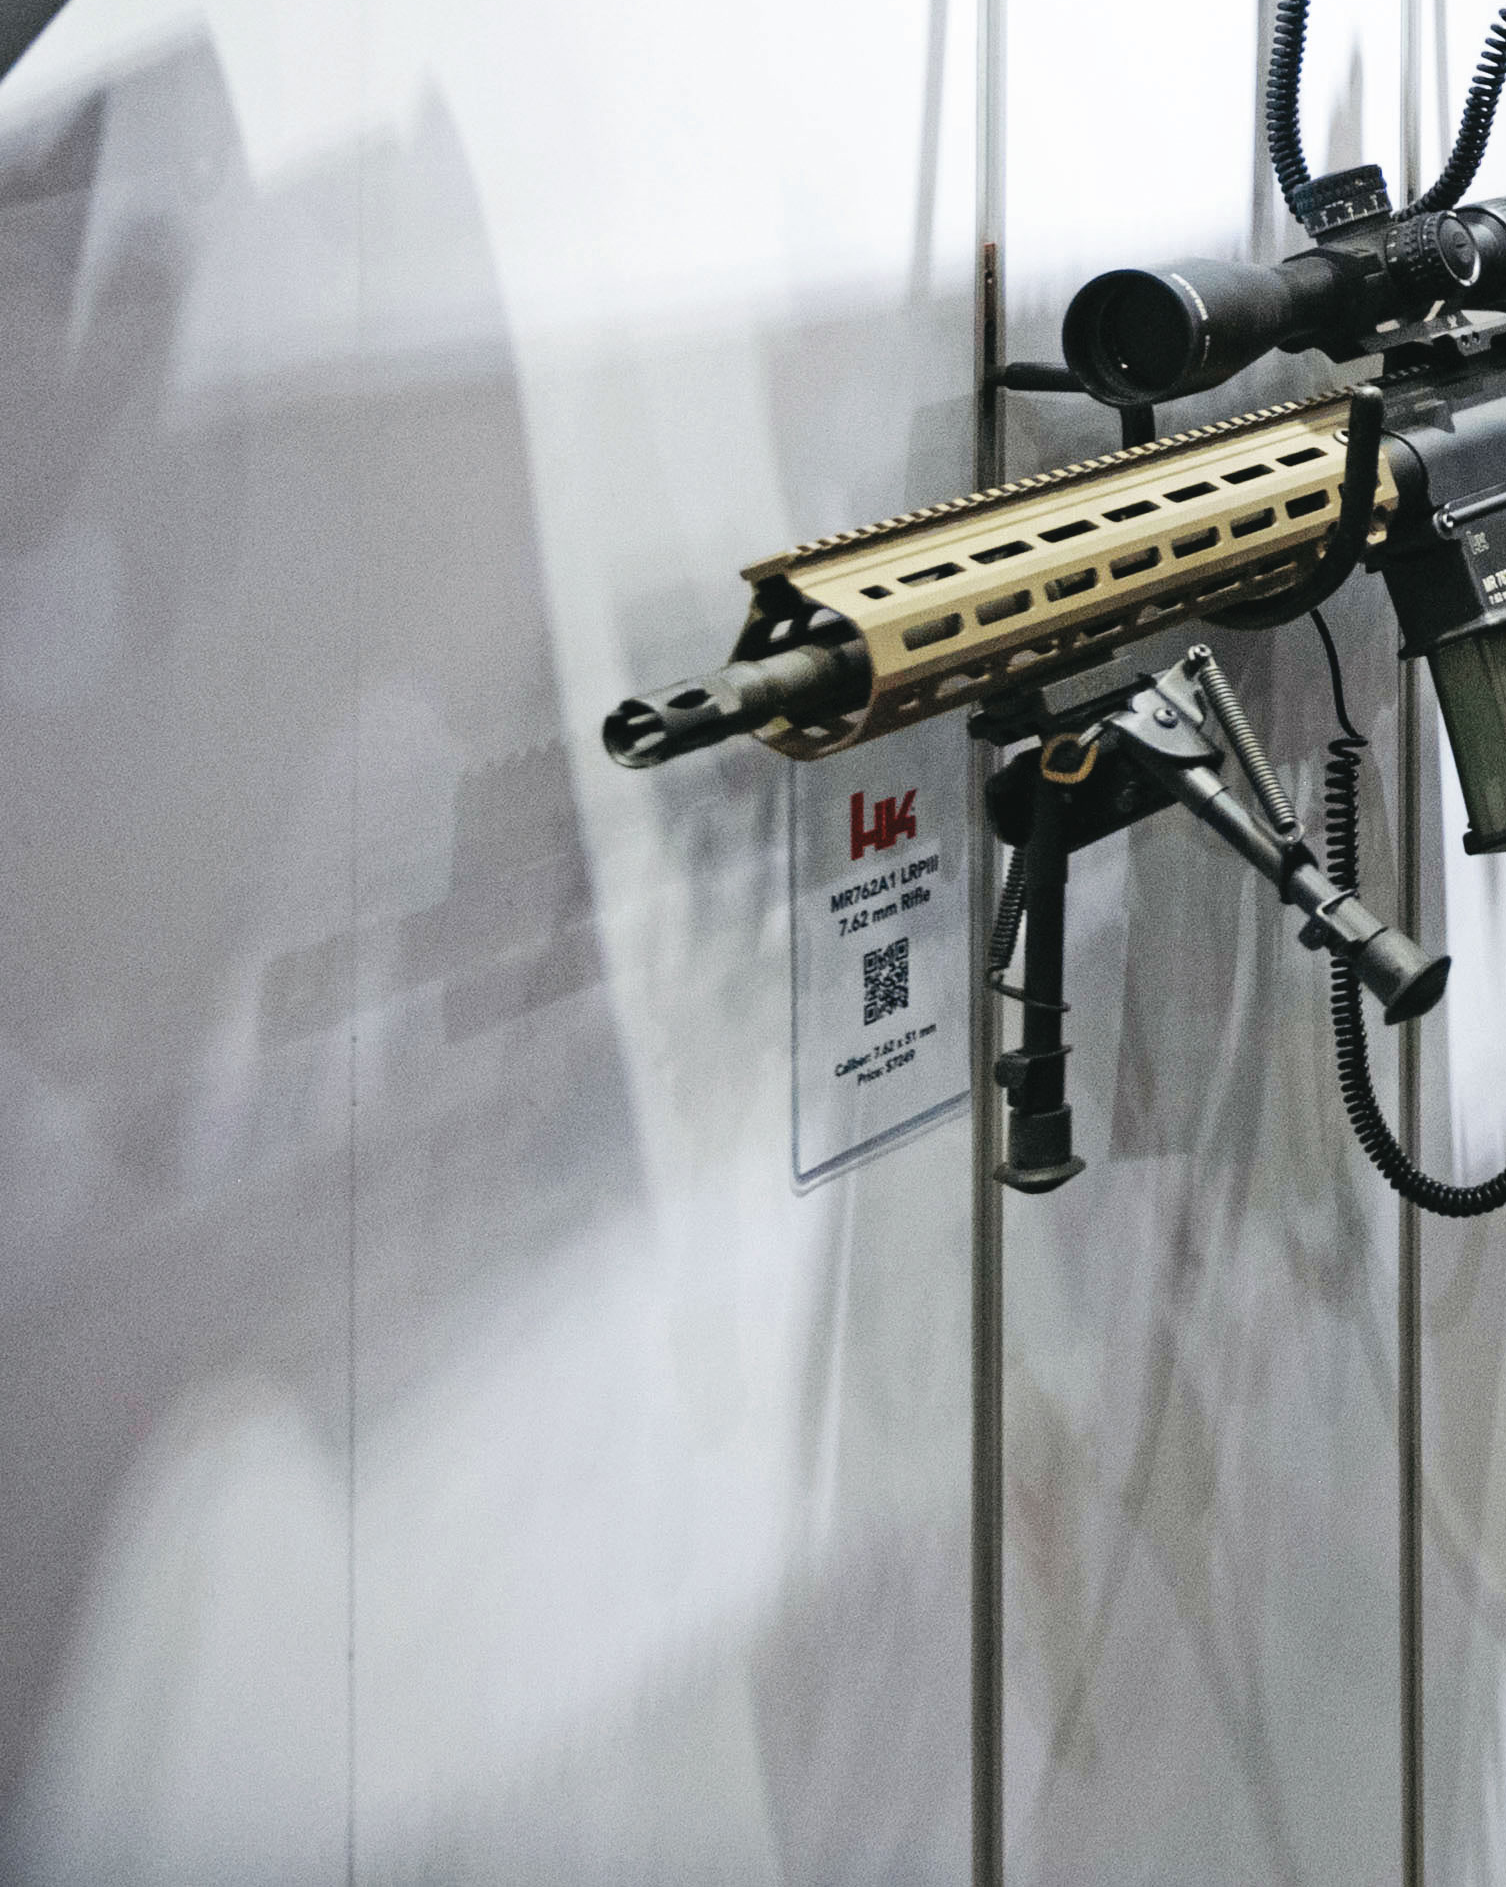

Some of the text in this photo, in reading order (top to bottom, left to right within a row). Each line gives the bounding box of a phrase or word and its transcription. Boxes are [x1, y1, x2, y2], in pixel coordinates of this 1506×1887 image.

[850, 787, 917, 861] HK
[831, 854, 939, 913] MR762A1 LRPIII
[839, 886, 931, 936] 7.62 mm Rifle
